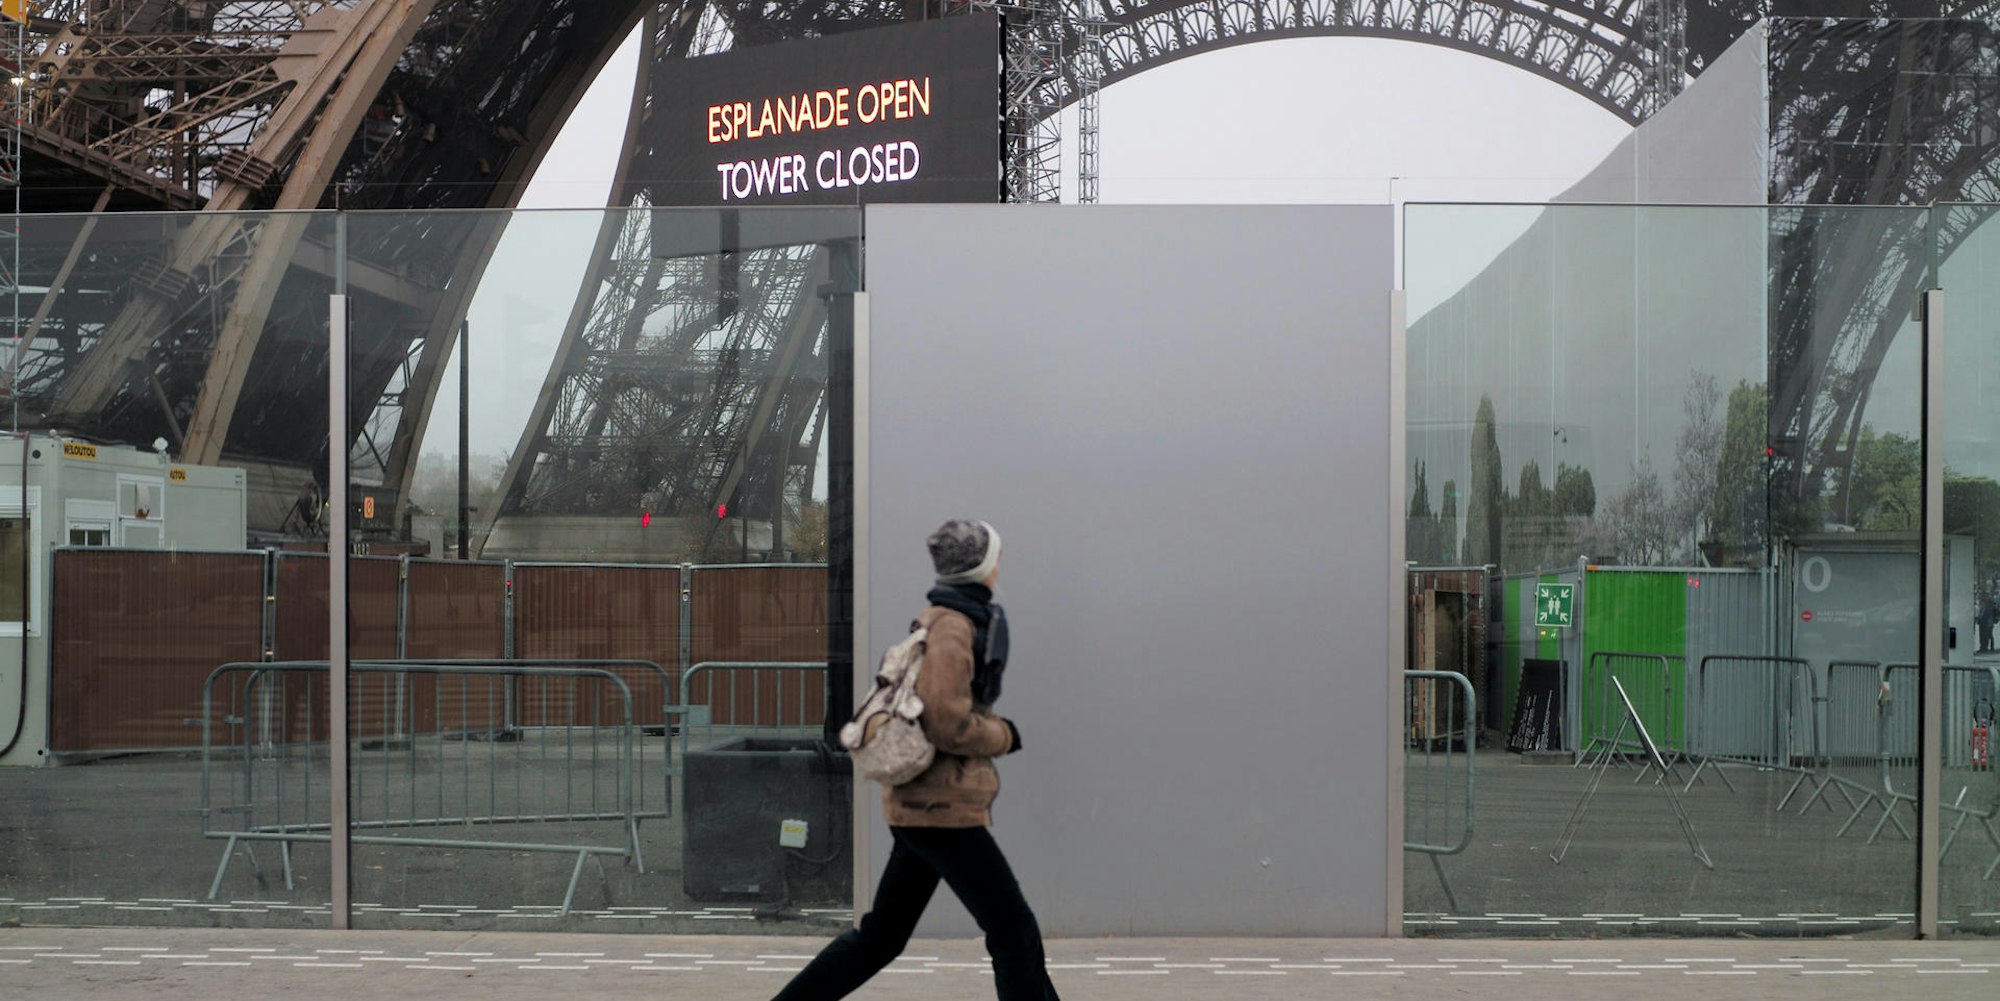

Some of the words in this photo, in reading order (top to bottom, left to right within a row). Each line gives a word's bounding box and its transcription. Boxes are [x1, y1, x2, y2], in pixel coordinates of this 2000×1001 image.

[708, 87, 850, 144] ESPLANADE
[856, 76, 930, 124] OPEN
[716, 153, 809, 201] TOWER
[815, 140, 920, 190] CLOSED
